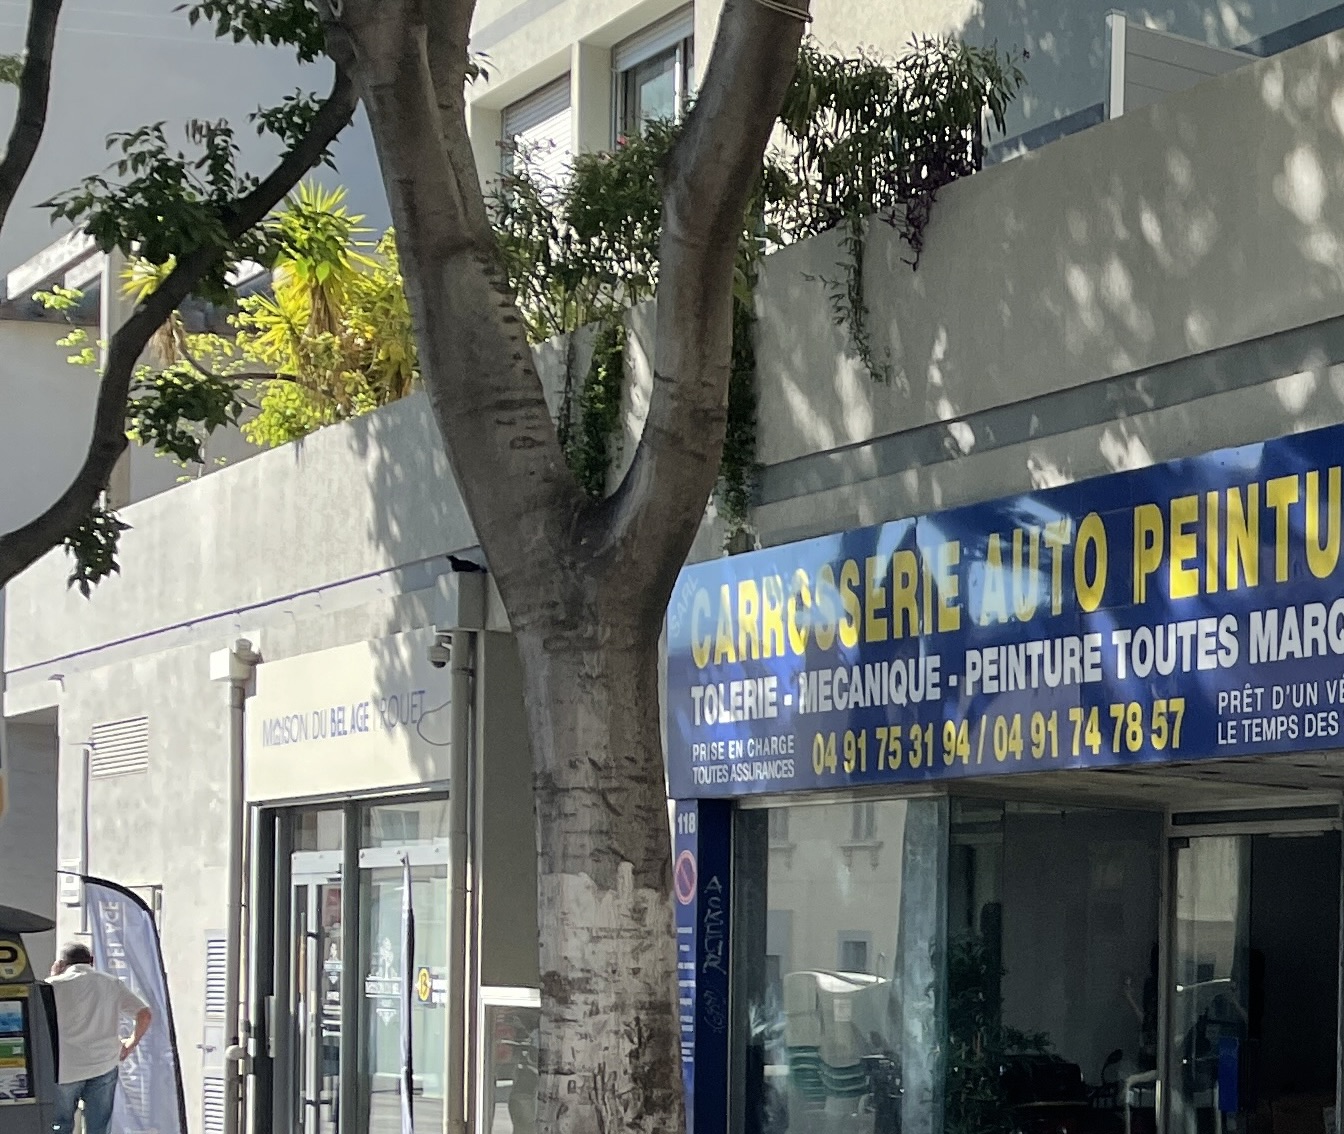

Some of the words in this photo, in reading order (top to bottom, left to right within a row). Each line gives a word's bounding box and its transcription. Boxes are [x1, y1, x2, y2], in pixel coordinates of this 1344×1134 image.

[691, 540, 961, 669] CARROSSERIE
[980, 511, 1108, 626] AUTO
[691, 676, 778, 726] TOLERIE
[799, 655, 941, 714] MECANIQUE
[966, 632, 1102, 697] PEINTURE
[1112, 613, 1239, 680] TOUTES
[312, 709, 327, 739] DU
[330, 706, 348, 737] BEL
[380, 690, 426, 730] ROUET
[1218, 683, 1264, 715] PRÊT
[1272, 680, 1319, 710] D'UN
[812, 731, 837, 775] 04
[843, 728, 866, 773] 91
[876, 726, 901, 771] 75
[909, 722, 933, 768] 31
[942, 719, 970, 766] 94
[993, 713, 1022, 763] 04
[1031, 709, 1058, 759] 91
[1068, 705, 1101, 756] 74
[1111, 701, 1144, 753] 78
[1150, 697, 1186, 750] 57
[1217, 721, 1237, 745] LE
[1241, 716, 1299, 743] TEMPS
[1304, 710, 1340, 737] DES
[692, 740, 725, 762] PRISE
[728, 739, 743, 759] EN
[747, 735, 795, 758] CHARGE
[692, 763, 730, 785] TOUTES
[730, 758, 795, 782] ASSURANCES
[677, 812, 696, 834] 118
